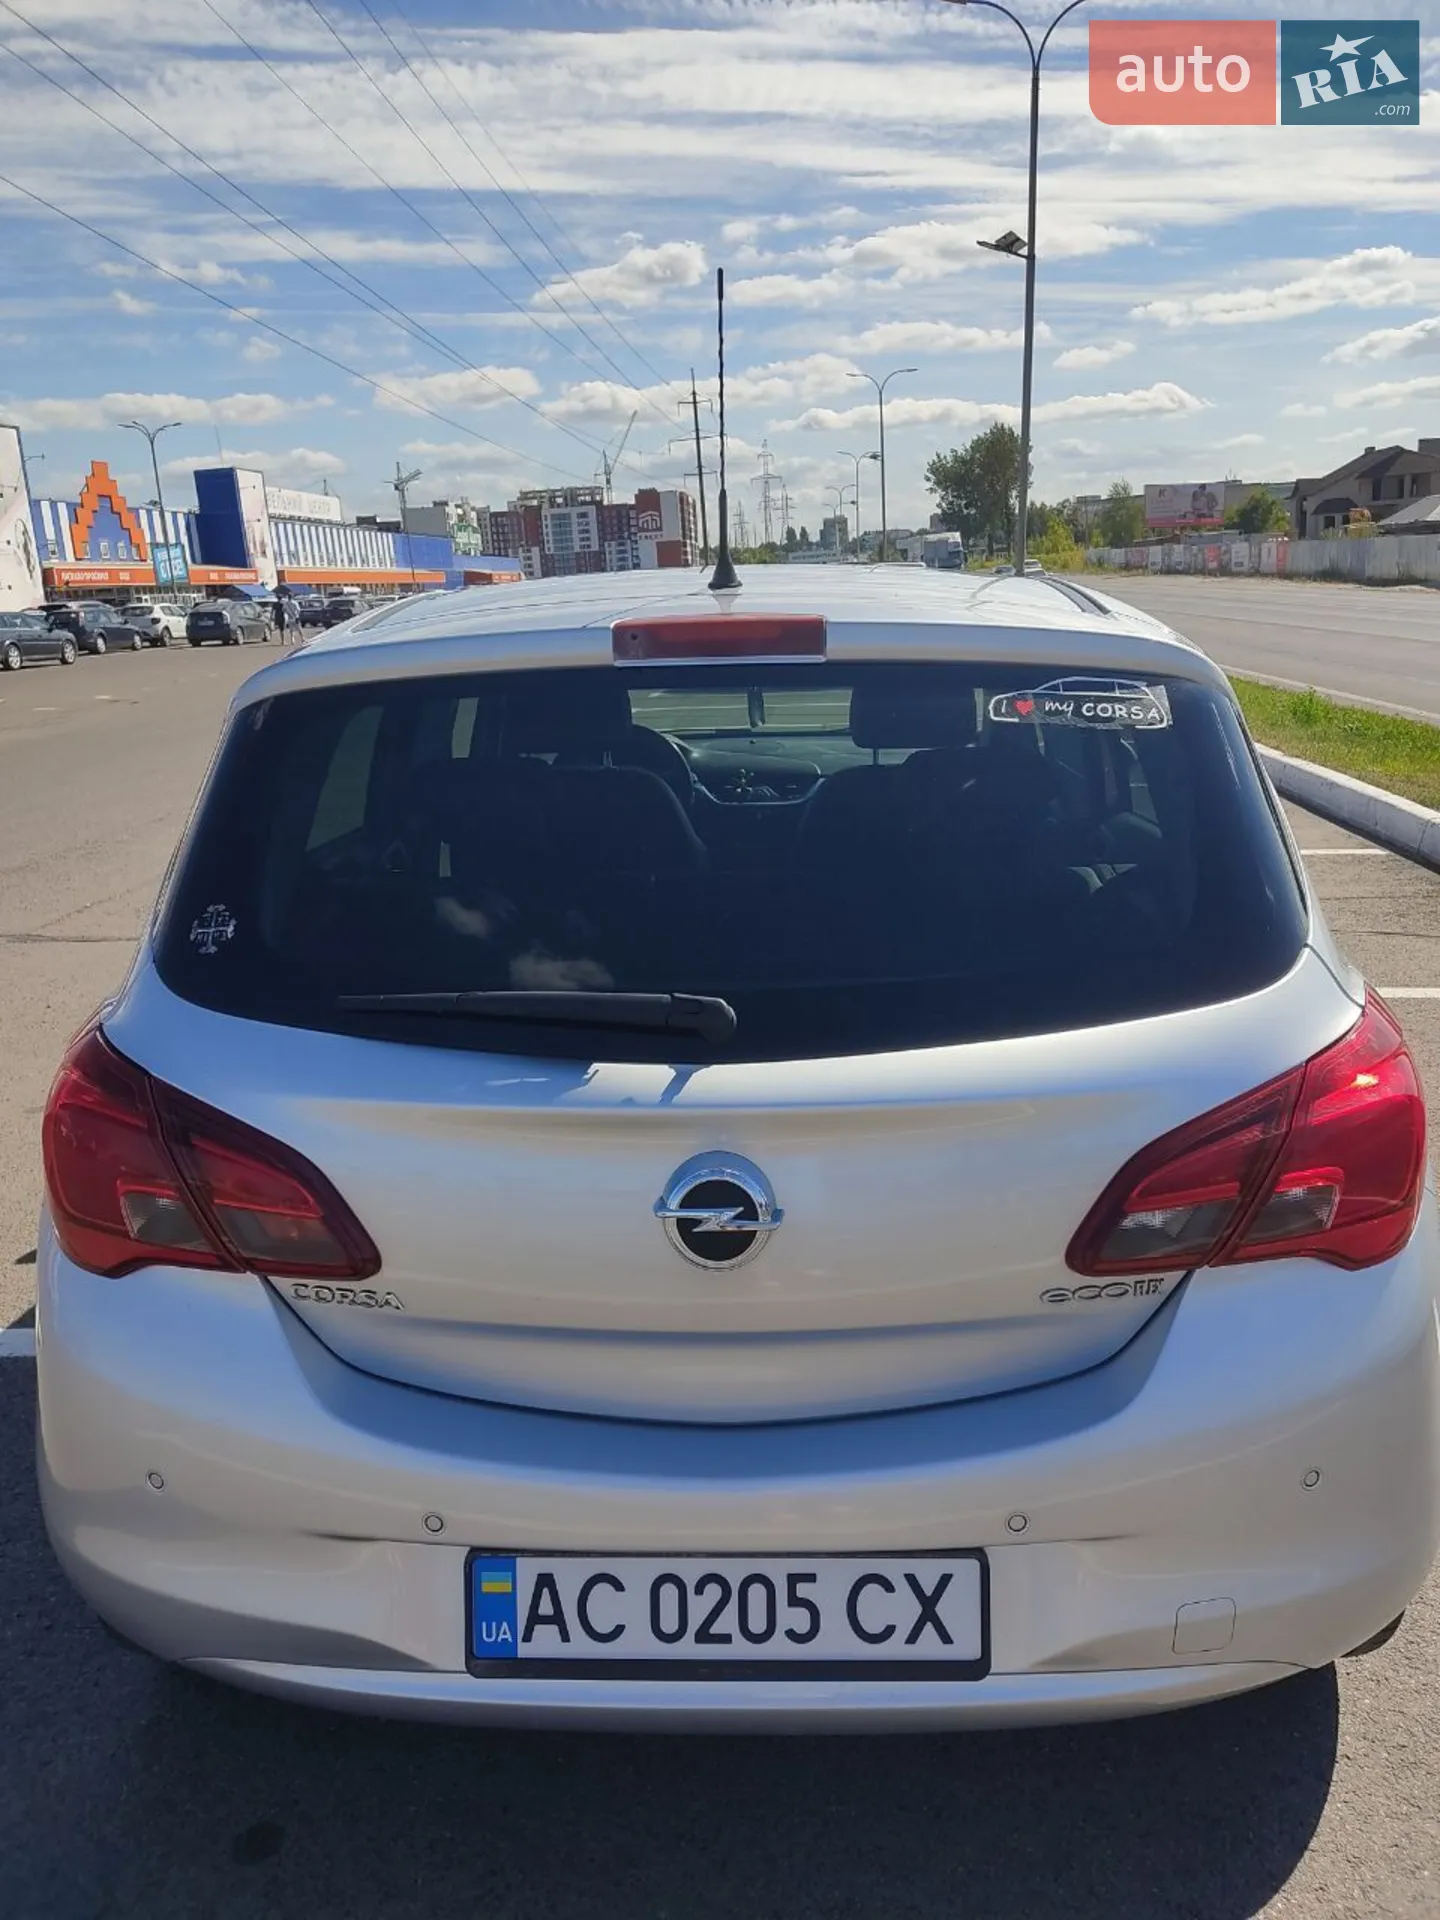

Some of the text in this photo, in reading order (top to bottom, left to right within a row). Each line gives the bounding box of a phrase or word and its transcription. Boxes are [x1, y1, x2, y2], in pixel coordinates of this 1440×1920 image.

[1044, 699, 1075, 717] my
[1081, 702, 1161, 721] CORSA
[290, 1283, 405, 1310] CORSA
[521, 1572, 954, 1645] AC 0205 CX
[481, 1621, 513, 1643] UA
